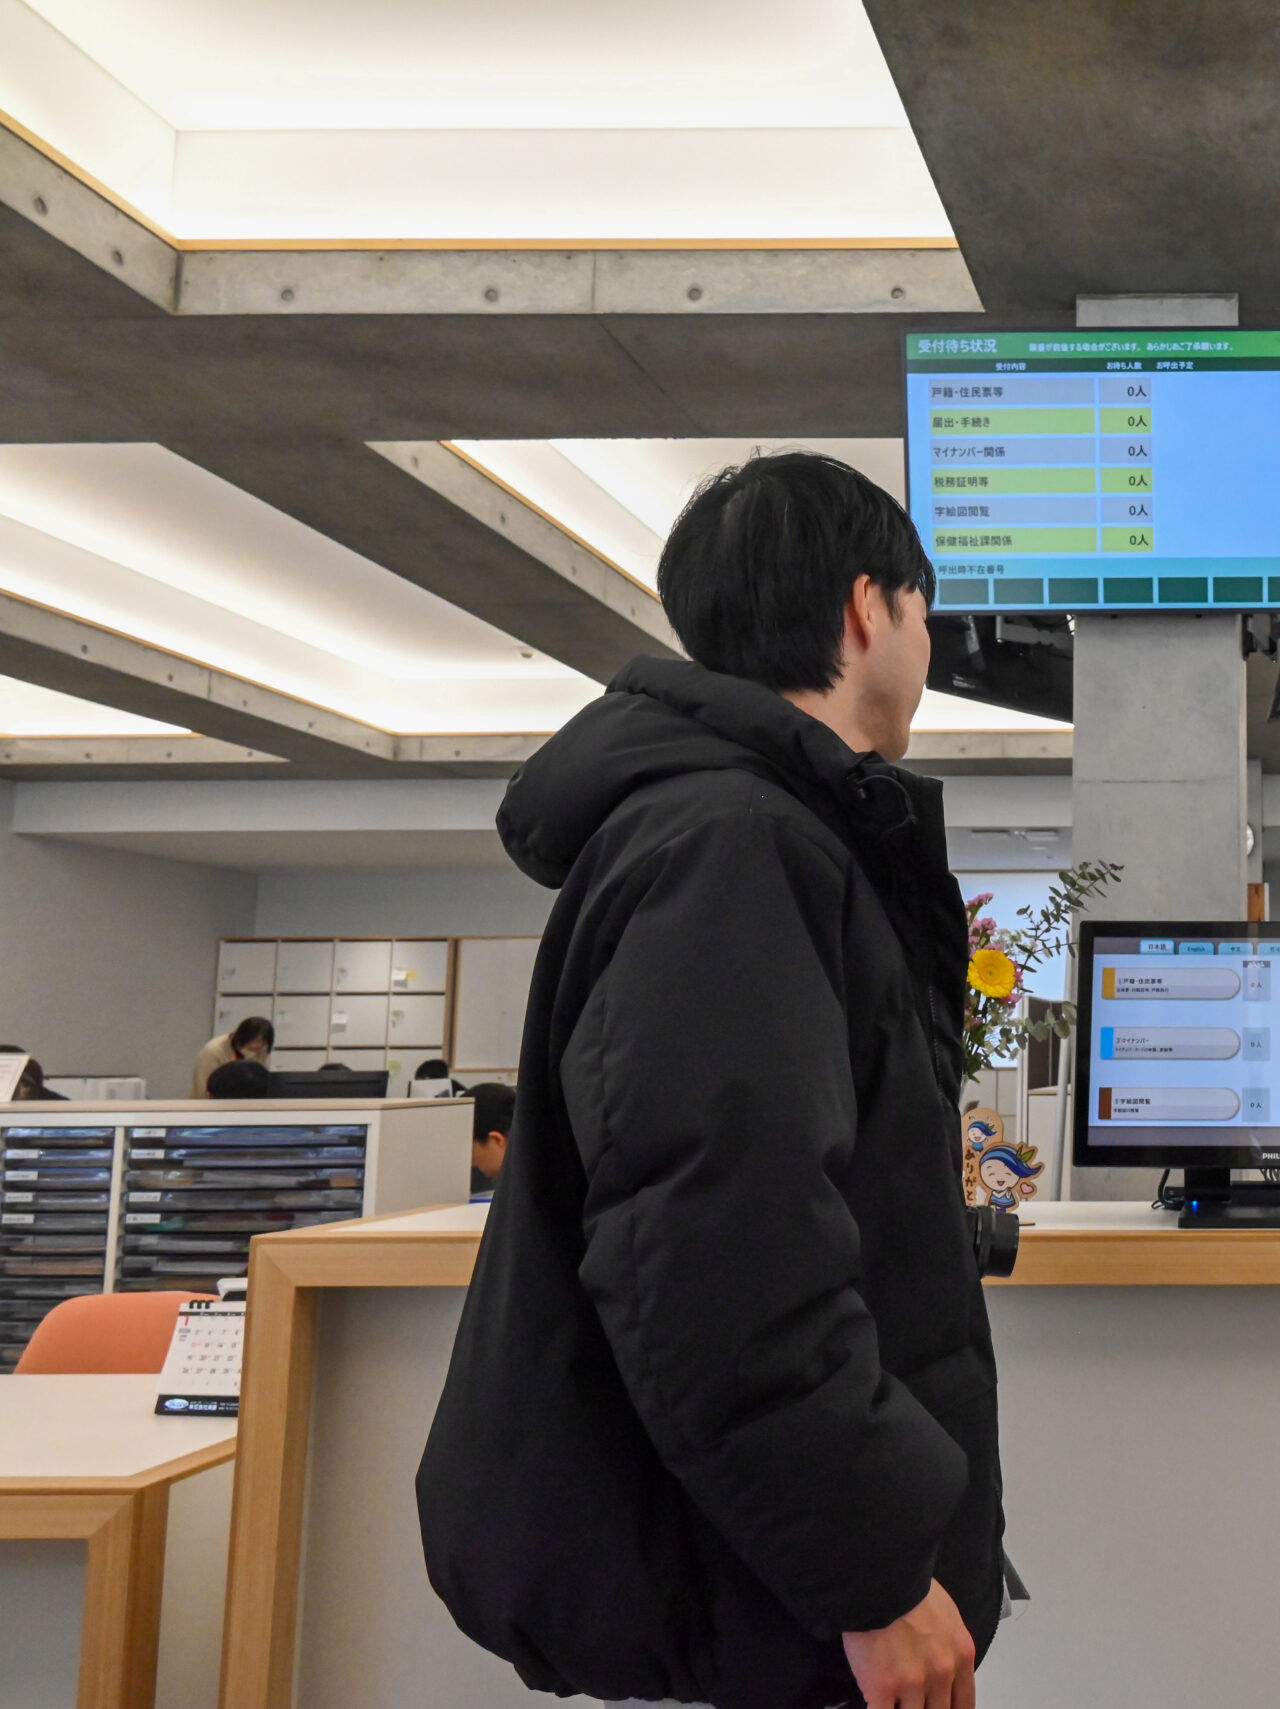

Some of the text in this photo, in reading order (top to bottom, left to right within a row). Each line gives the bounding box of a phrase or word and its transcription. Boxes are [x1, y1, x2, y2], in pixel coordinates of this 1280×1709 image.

[918, 339, 997, 353] 受付待ち状況
[995, 362, 1026, 371] 受付内容
[1106, 362, 1142, 370] お待ち人数
[1156, 361, 1194, 370] お呼出予定
[932, 386, 1003, 398] 戸籍・住民票等
[1127, 385, 1147, 397] 0人
[932, 417, 990, 428] 届出・手続き
[1127, 416, 1147, 427] 0人
[933, 446, 1005, 458] マイナンバー関係
[1128, 445, 1147, 457] 0人
[934, 476, 989, 488] 税務証明等
[1128, 475, 1148, 487] 0人
[1129, 505, 1148, 516] 0人
[935, 536, 1012, 546] 保健福祉課関係
[1129, 534, 1149, 546] 0人
[938, 564, 1004, 574] 呼出時不在番号
[965, 1148, 976, 1206] ありがと
